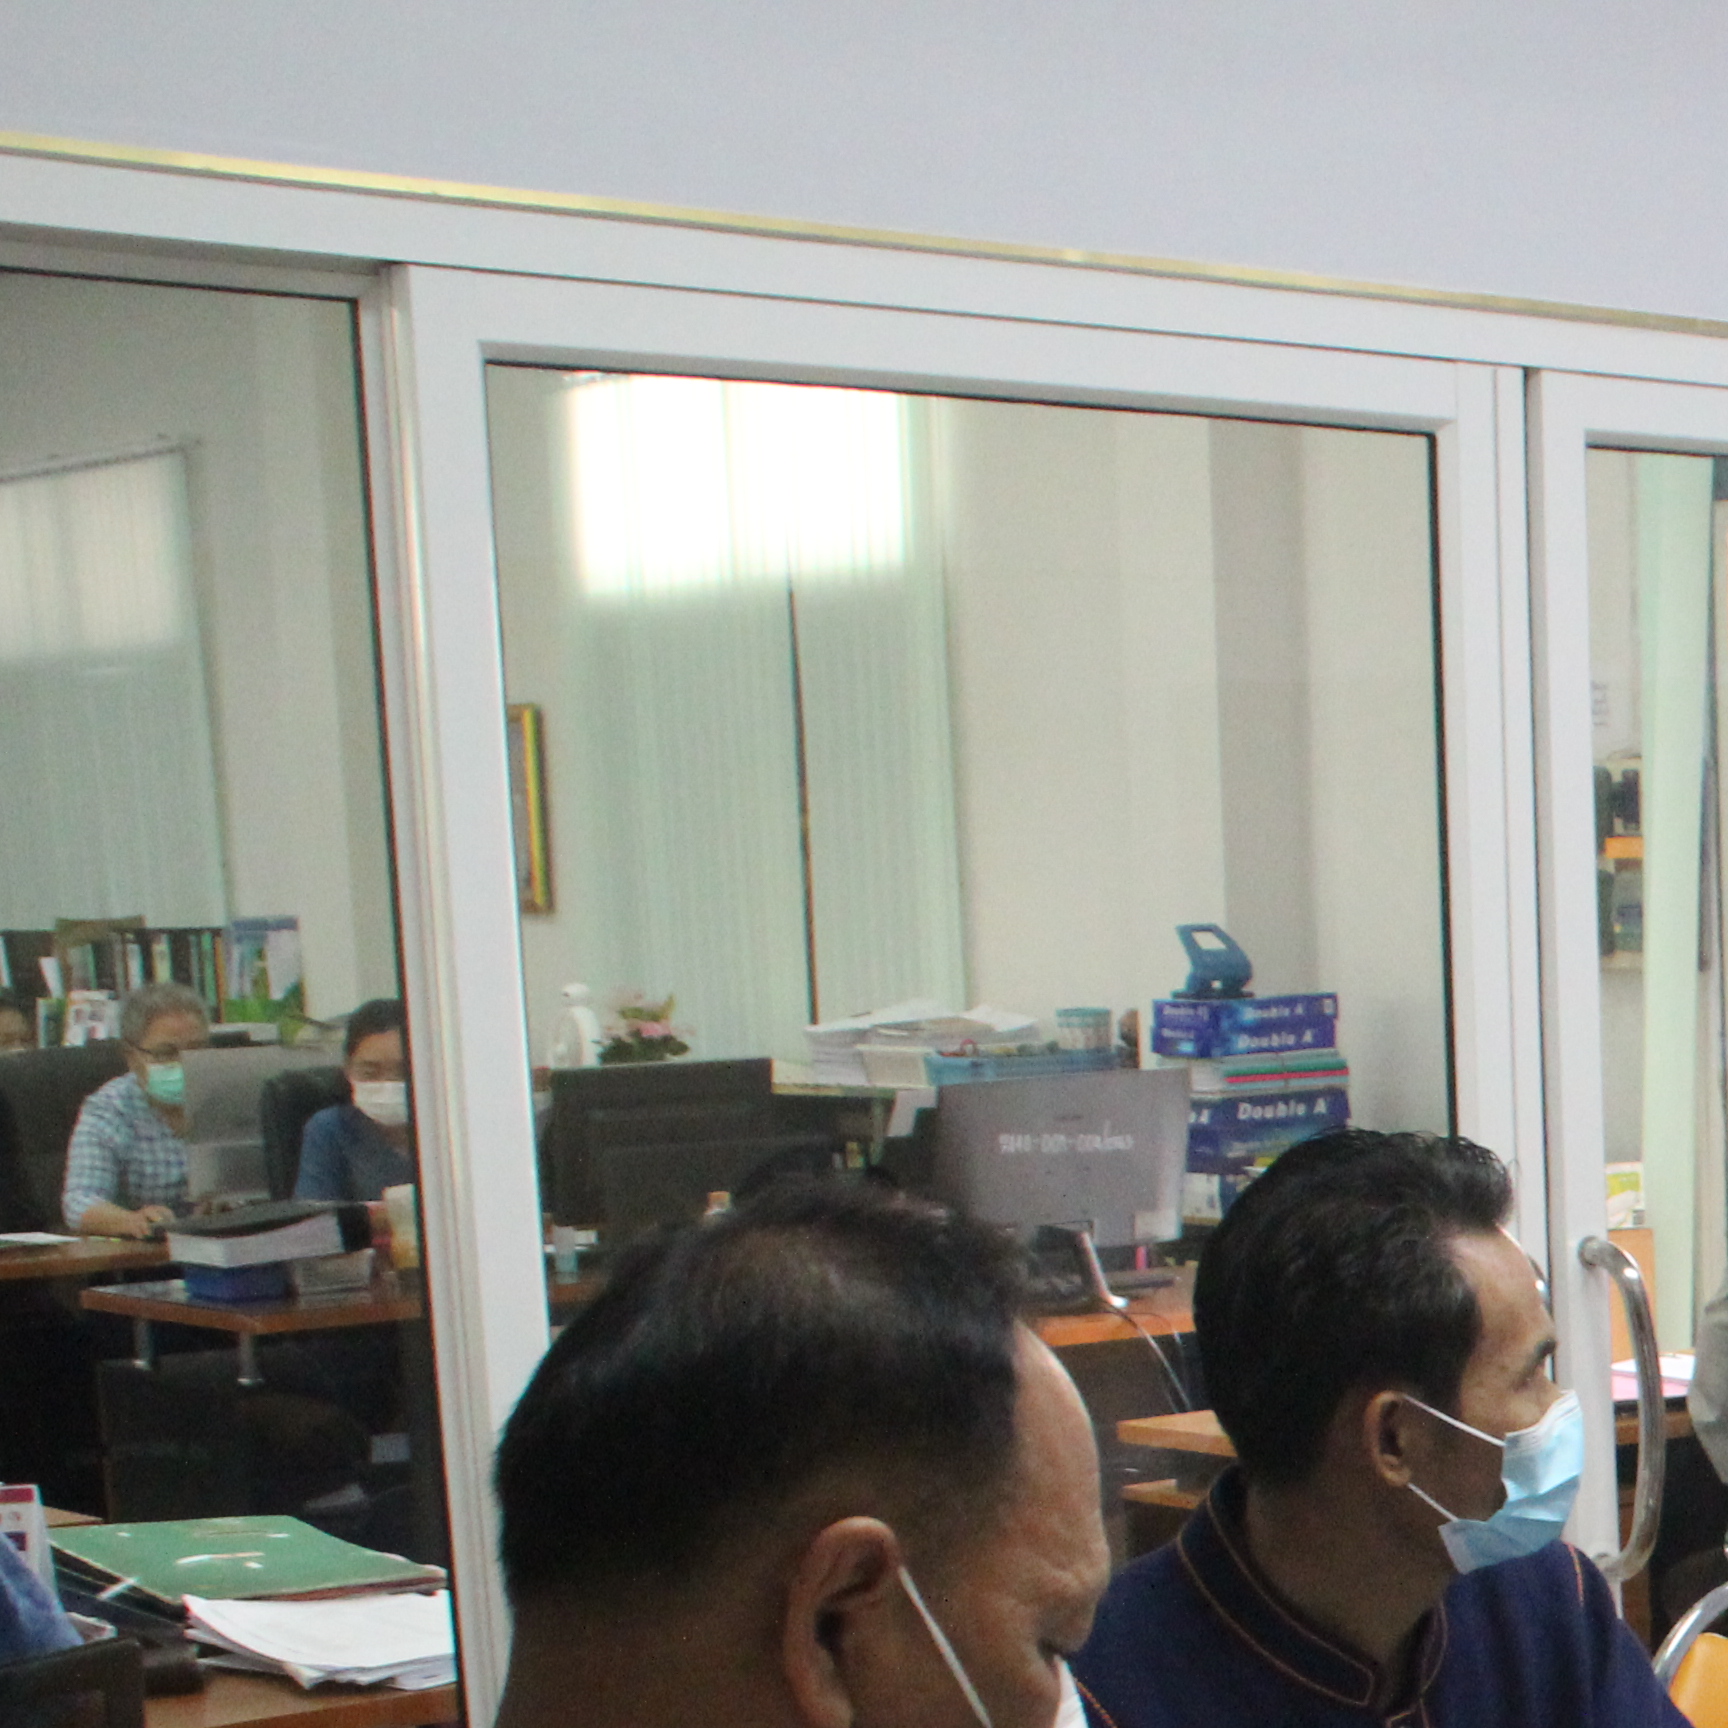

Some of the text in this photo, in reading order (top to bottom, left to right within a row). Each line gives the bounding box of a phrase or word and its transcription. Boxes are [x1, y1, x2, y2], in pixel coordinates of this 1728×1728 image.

[1237, 1029, 1314, 1049] Double A
[1237, 1097, 1328, 1121] Double A
